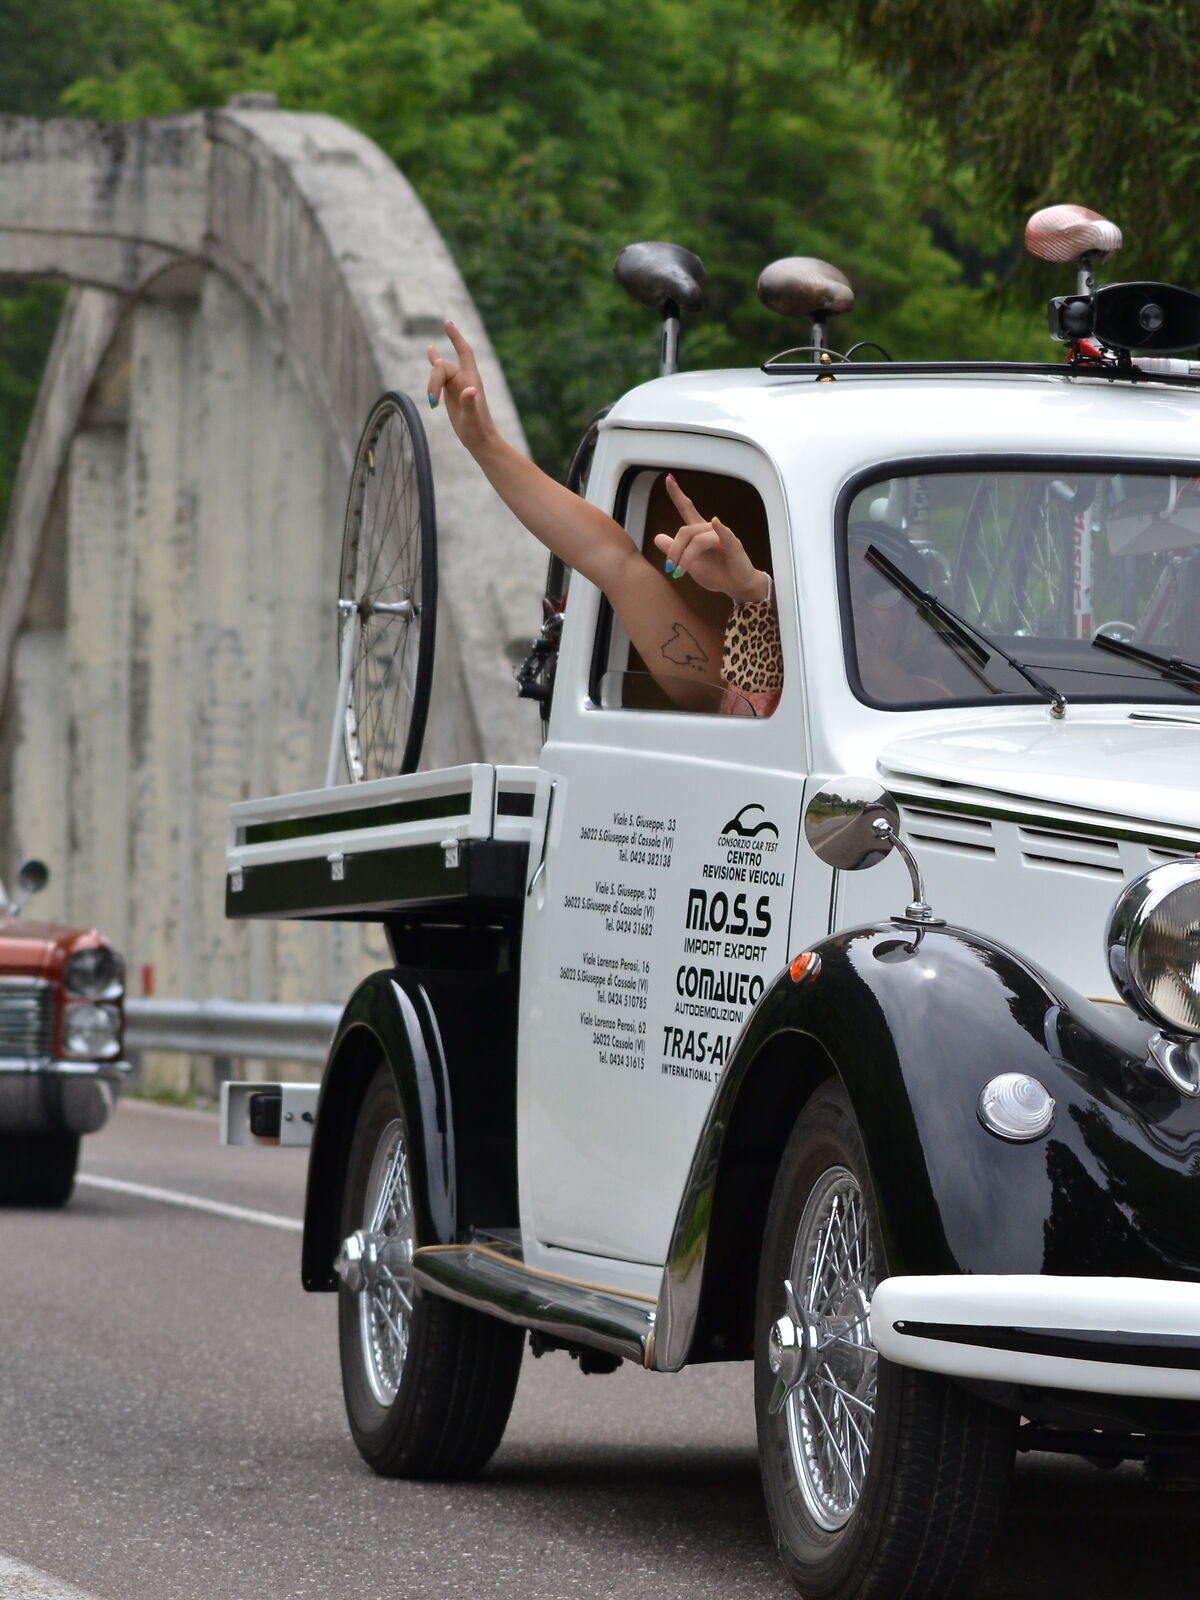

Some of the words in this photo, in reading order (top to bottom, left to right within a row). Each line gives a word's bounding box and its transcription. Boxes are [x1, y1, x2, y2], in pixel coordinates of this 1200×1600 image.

[613, 813, 628, 826] Viale
[629, 815, 634, 826] S.
[636, 815, 666, 832] Giuseppe,
[668, 818, 676, 832] 33
[580, 827, 598, 841] 36022
[630, 832, 637, 845] di
[638, 834, 661, 848] Cassola
[662, 836, 674, 852] (VI)
[717, 837, 750, 850] CONSORZIO
[752, 840, 764, 851] CAR
[764, 842, 779, 853] TEST
[618, 850, 628, 862] Tel.
[630, 851, 646, 865] 0424
[647, 852, 672, 868] 382138
[726, 850, 762, 866] CENTRO
[702, 864, 747, 882] REVISIONE
[749, 870, 785, 887] VEICOLI
[595, 881, 609, 895] Viale
[610, 883, 616, 896] S.
[617, 884, 646, 901] Giuseppe,
[648, 888, 656, 900] 33
[564, 896, 581, 909] 36022
[612, 900, 619, 913] di
[620, 902, 642, 917] Cassola
[644, 904, 655, 920] (VI)
[605, 918, 615, 931] Tel.
[616, 920, 632, 934] 0424
[632, 922, 653, 936] 31682
[684, 938, 722, 956] IMPORT
[724, 943, 768, 962] EXPORT
[582, 952, 596, 965] Viale
[597, 955, 619, 969] Lorenzo
[620, 958, 640, 973] Perosi,
[642, 960, 650, 974] 16
[560, 967, 576, 980] 36022
[607, 974, 613, 986] di
[614, 975, 636, 990] Cassola
[638, 978, 649, 994] (VI)
[676, 965, 765, 1006] COMAUTO
[597, 990, 606, 1003] Tel.
[608, 992, 622, 1005] 0424
[624, 994, 648, 1010] 510785
[580, 1012, 594, 1026] Viale
[594, 1015, 616, 1029] Lorenzo
[616, 1018, 637, 1034] Perosi,
[638, 1022, 647, 1034] 62
[674, 1002, 744, 1024] AUTODEMOLIZIONI
[592, 1032, 611, 1047] 36022
[611, 1035, 634, 1051] Cassola
[635, 1038, 646, 1055] (VI)
[598, 1052, 608, 1064] Tel.
[610, 1054, 624, 1066] 0424
[626, 1055, 645, 1070] 31615
[661, 1063, 712, 1083] INTERNATIONAL
